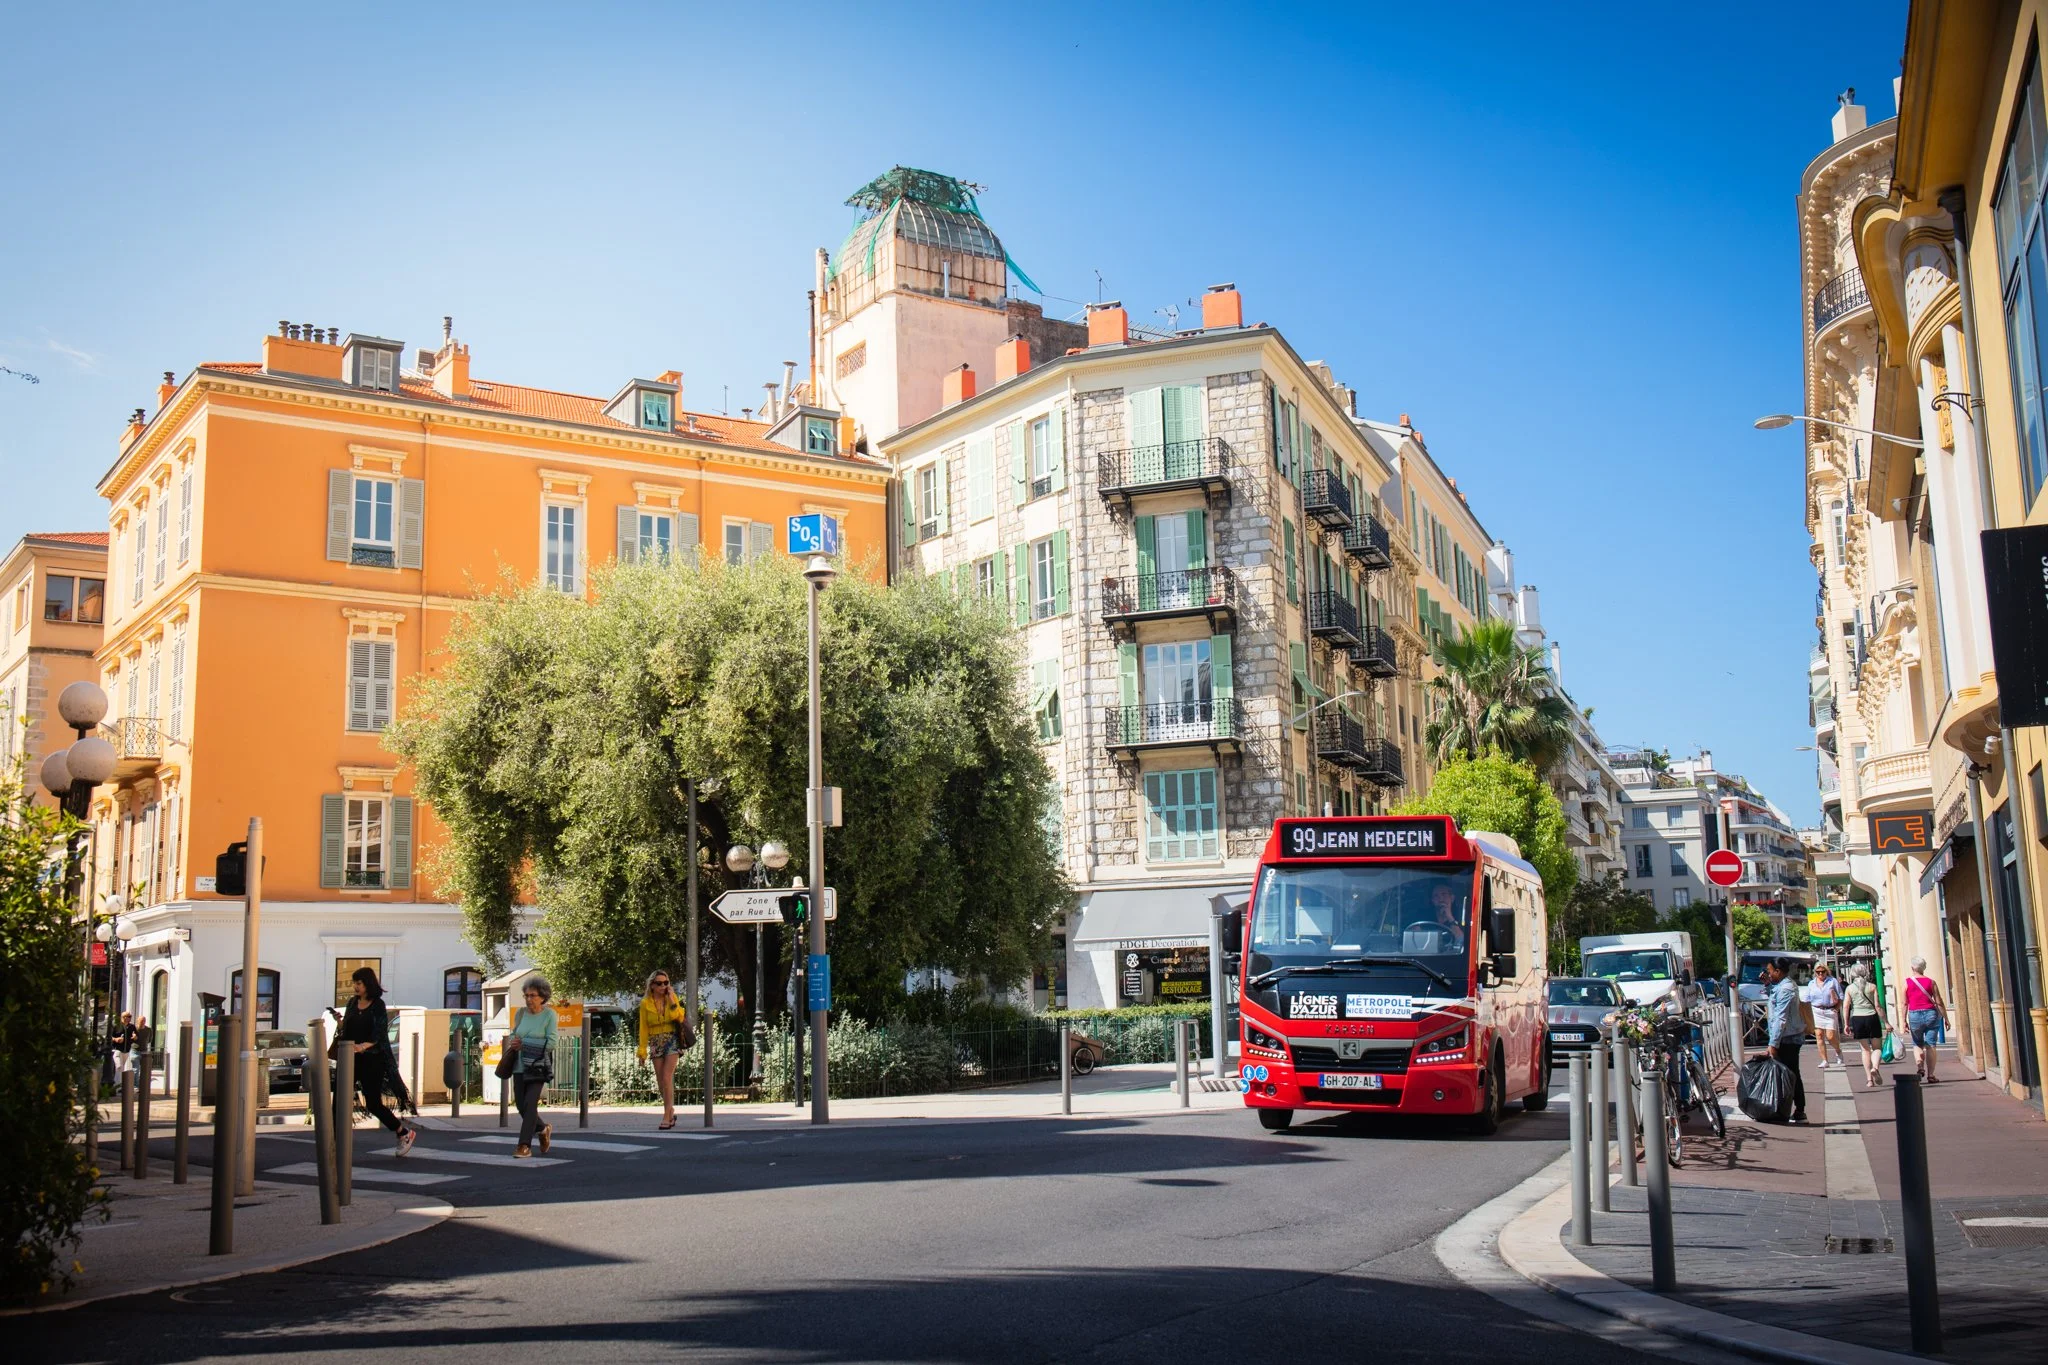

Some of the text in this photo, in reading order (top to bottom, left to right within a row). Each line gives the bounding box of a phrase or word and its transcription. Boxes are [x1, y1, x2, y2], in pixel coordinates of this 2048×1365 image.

[791, 517, 820, 550] SOS
[823, 516, 837, 555] SOS
[1293, 828, 1433, 853] 99 JEAN MEDECIN
[747, 897, 768, 905] Zone
[730, 910, 744, 918] par
[1811, 919, 1871, 930] PESARZOLI
[1120, 940, 1148, 949] EDGE
[1290, 992, 1338, 1005] LIGNES
[1346, 995, 1412, 1007] MÉTROPOLE
[209, 1008, 216, 1018] P
[1290, 1005, 1338, 1015] D'AZUR
